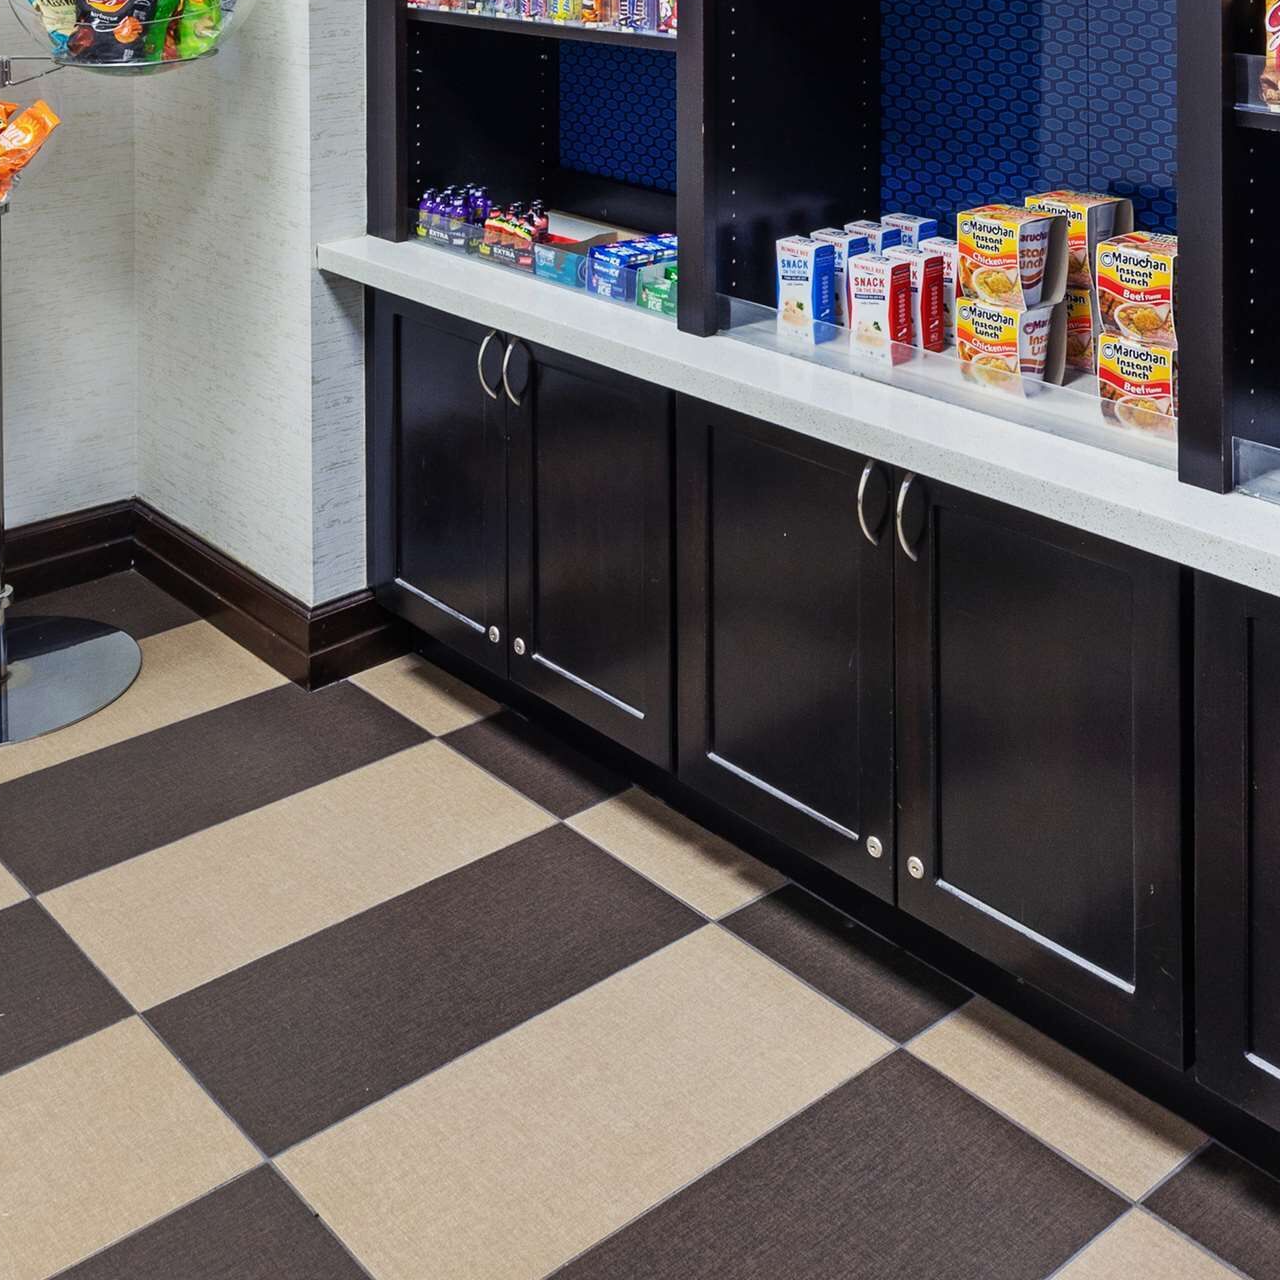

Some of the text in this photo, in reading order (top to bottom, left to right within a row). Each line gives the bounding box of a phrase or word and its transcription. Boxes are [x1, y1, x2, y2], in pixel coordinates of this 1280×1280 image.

[429, 228, 449, 240] EXTRA
[969, 220, 1014, 238] Maruchan
[973, 232, 1003, 246] Instant
[493, 246, 515, 258] EXTRA
[976, 241, 1000, 253] Lunch
[781, 258, 809, 270] SNACK
[972, 251, 1004, 266] Chicken
[1020, 258, 1043, 270] unch
[1112, 251, 1167, 272] Maruchan
[1116, 265, 1153, 280] Instant
[854, 277, 886, 288] SNACK
[1120, 274, 1149, 287] Lunch
[597, 284, 612, 297] ICE
[1122, 288, 1145, 301] Beef
[647, 298, 663, 312] ICE
[969, 306, 1014, 326] Maruchan
[972, 318, 1003, 333] Instant
[975, 326, 1000, 340] Lunch
[971, 338, 1002, 353] Chicken
[1113, 343, 1167, 366] Maruchan
[1116, 357, 1153, 373] Instant
[1120, 365, 1149, 380] Lunch
[1123, 381, 1145, 395] Beef
